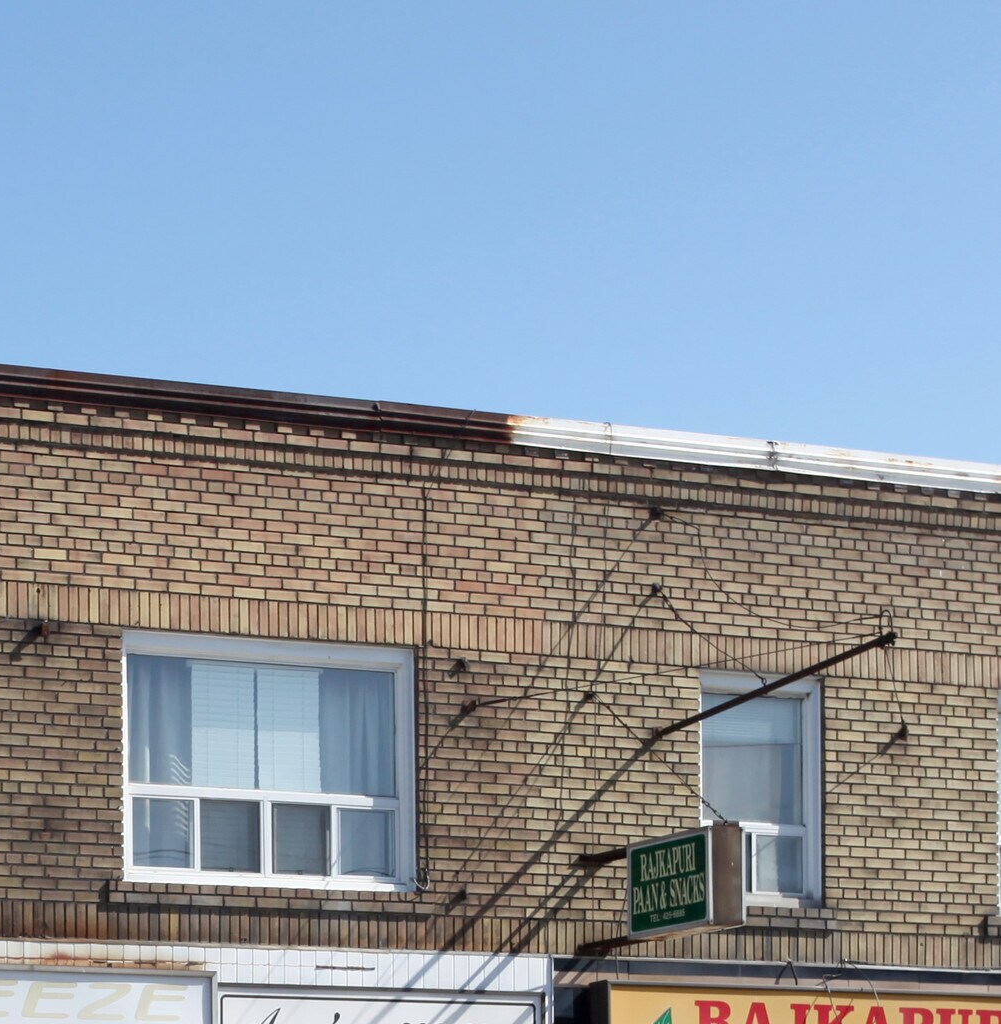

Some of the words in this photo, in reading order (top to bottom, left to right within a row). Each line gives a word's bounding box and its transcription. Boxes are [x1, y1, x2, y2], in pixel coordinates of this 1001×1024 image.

[640, 842, 696, 882] RAJKAPURI
[633, 882, 659, 915] PAAN
[659, 882, 668, 910] &
[669, 872, 705, 908] SNACKS
